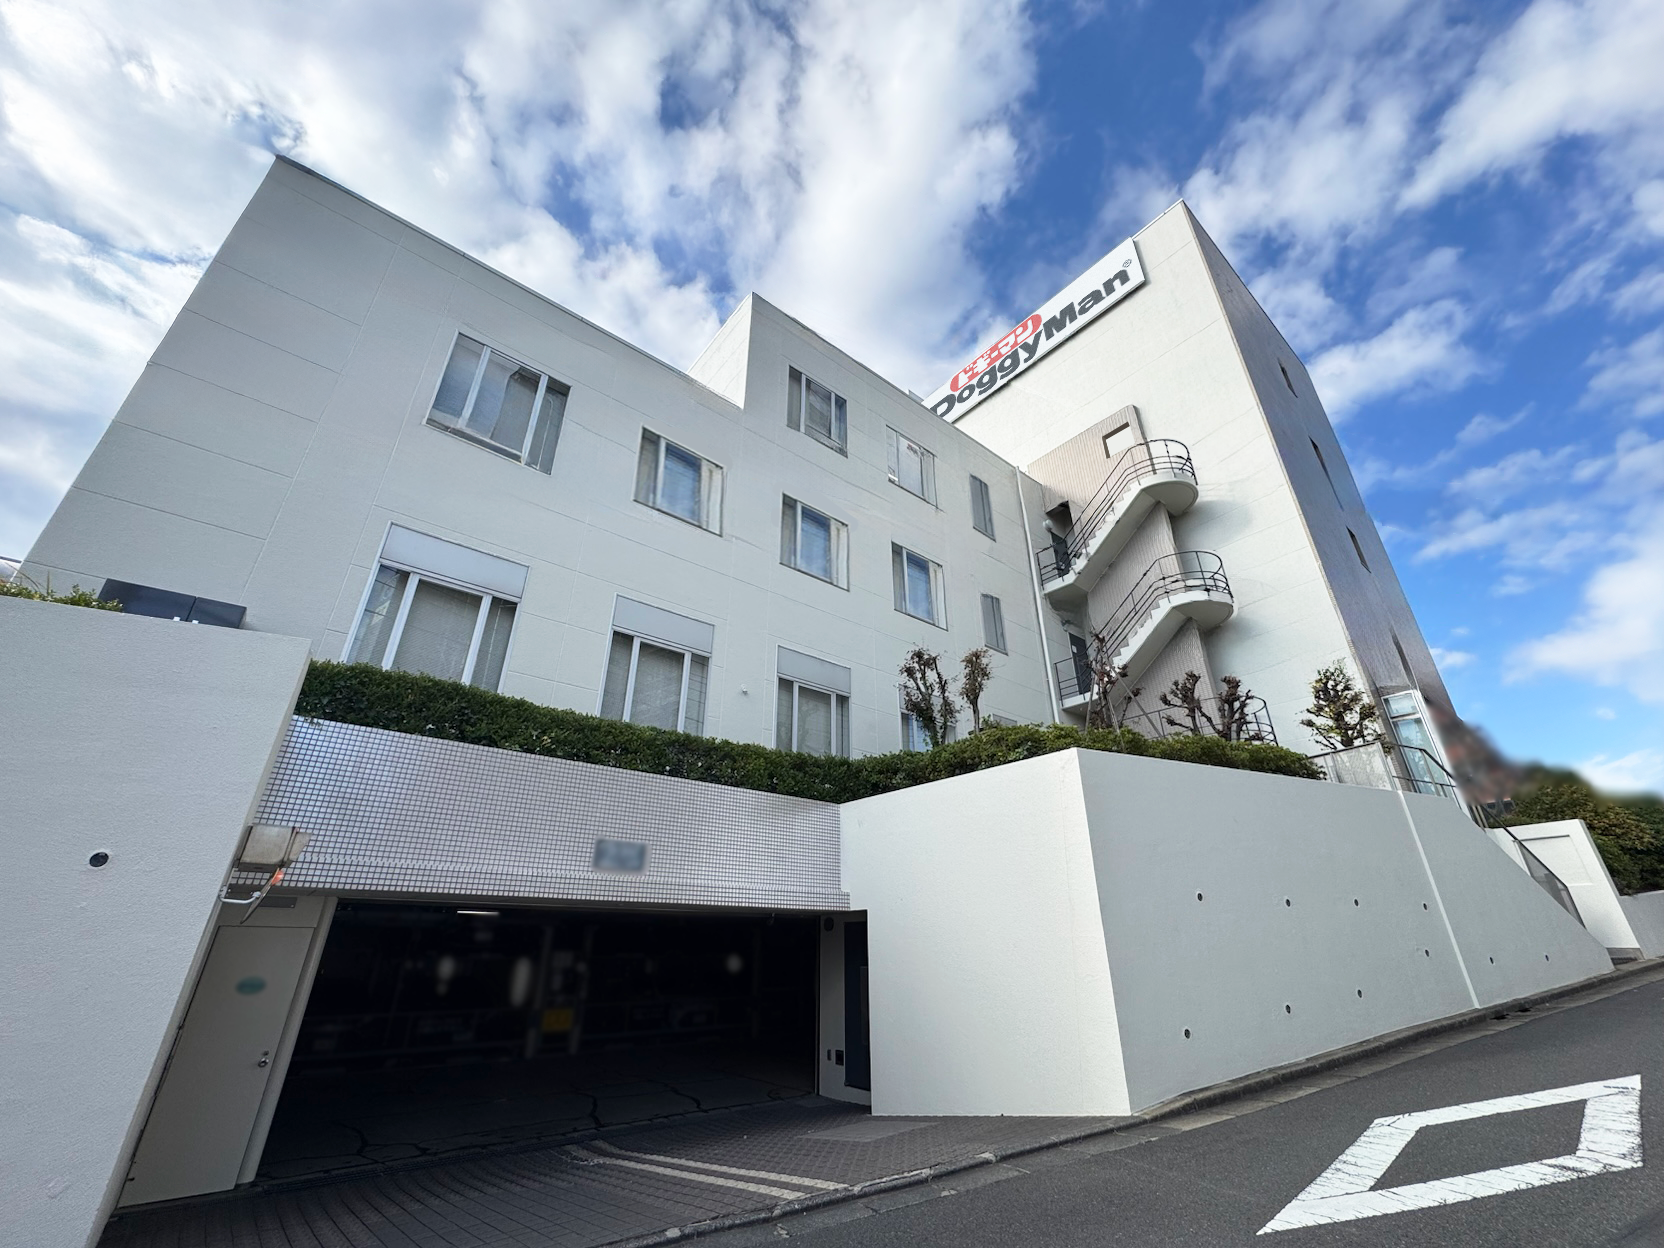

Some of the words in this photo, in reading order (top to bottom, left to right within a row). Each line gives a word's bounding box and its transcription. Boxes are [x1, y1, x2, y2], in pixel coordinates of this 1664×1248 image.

[958, 319, 1033, 388] ドギーマン
